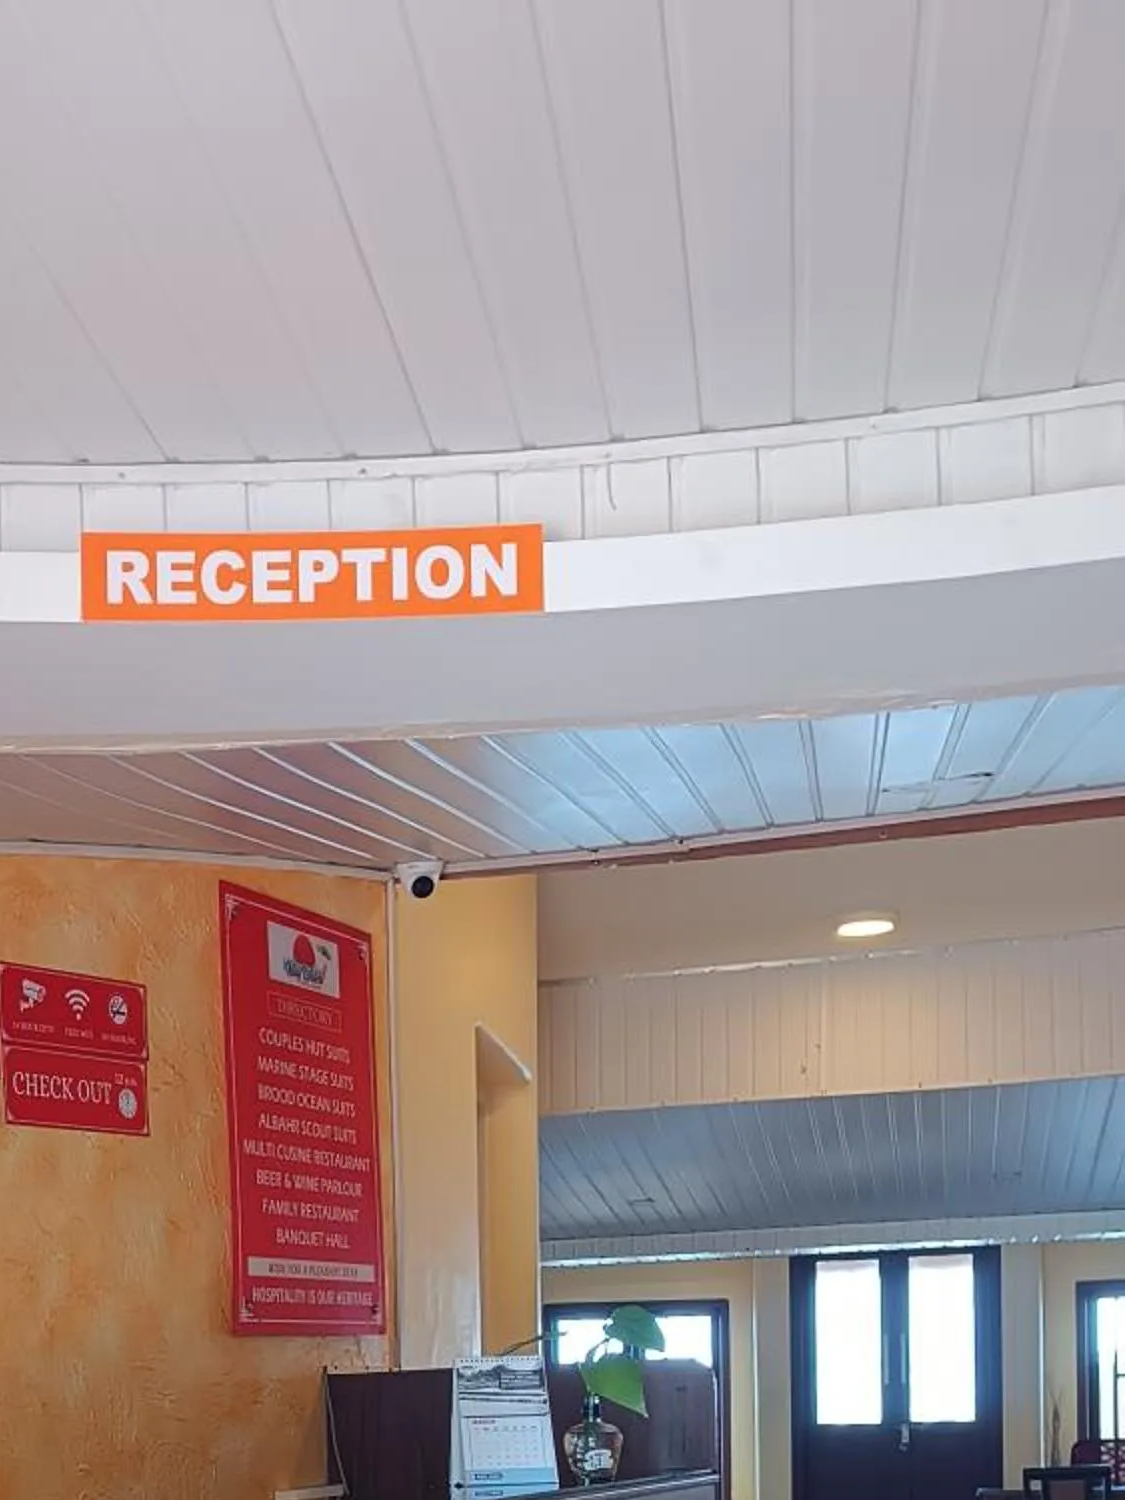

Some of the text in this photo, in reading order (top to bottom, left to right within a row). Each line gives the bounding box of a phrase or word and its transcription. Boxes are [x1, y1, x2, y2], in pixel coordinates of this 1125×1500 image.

[106, 543, 518, 605] RECEPTION
[259, 1027, 303, 1052] COUPLES
[305, 1040, 324, 1057] HUT
[258, 1055, 297, 1078] MARINE
[299, 1065, 329, 1085] STAGE
[12, 1071, 75, 1101] CHECK
[77, 1079, 112, 1105] OUT
[297, 1092, 331, 1113] OCEAN
[243, 1139, 275, 1158] MULTI
[314, 1150, 370, 1172] RESTAURANT
[256, 1168, 362, 1197] BEER & WINE PARLOUR
[262, 1198, 359, 1222] FAMILY RESTAURANT
[276, 1227, 351, 1249] BANQUET HALL
[252, 1286, 306, 1304] HOSPITALITY
